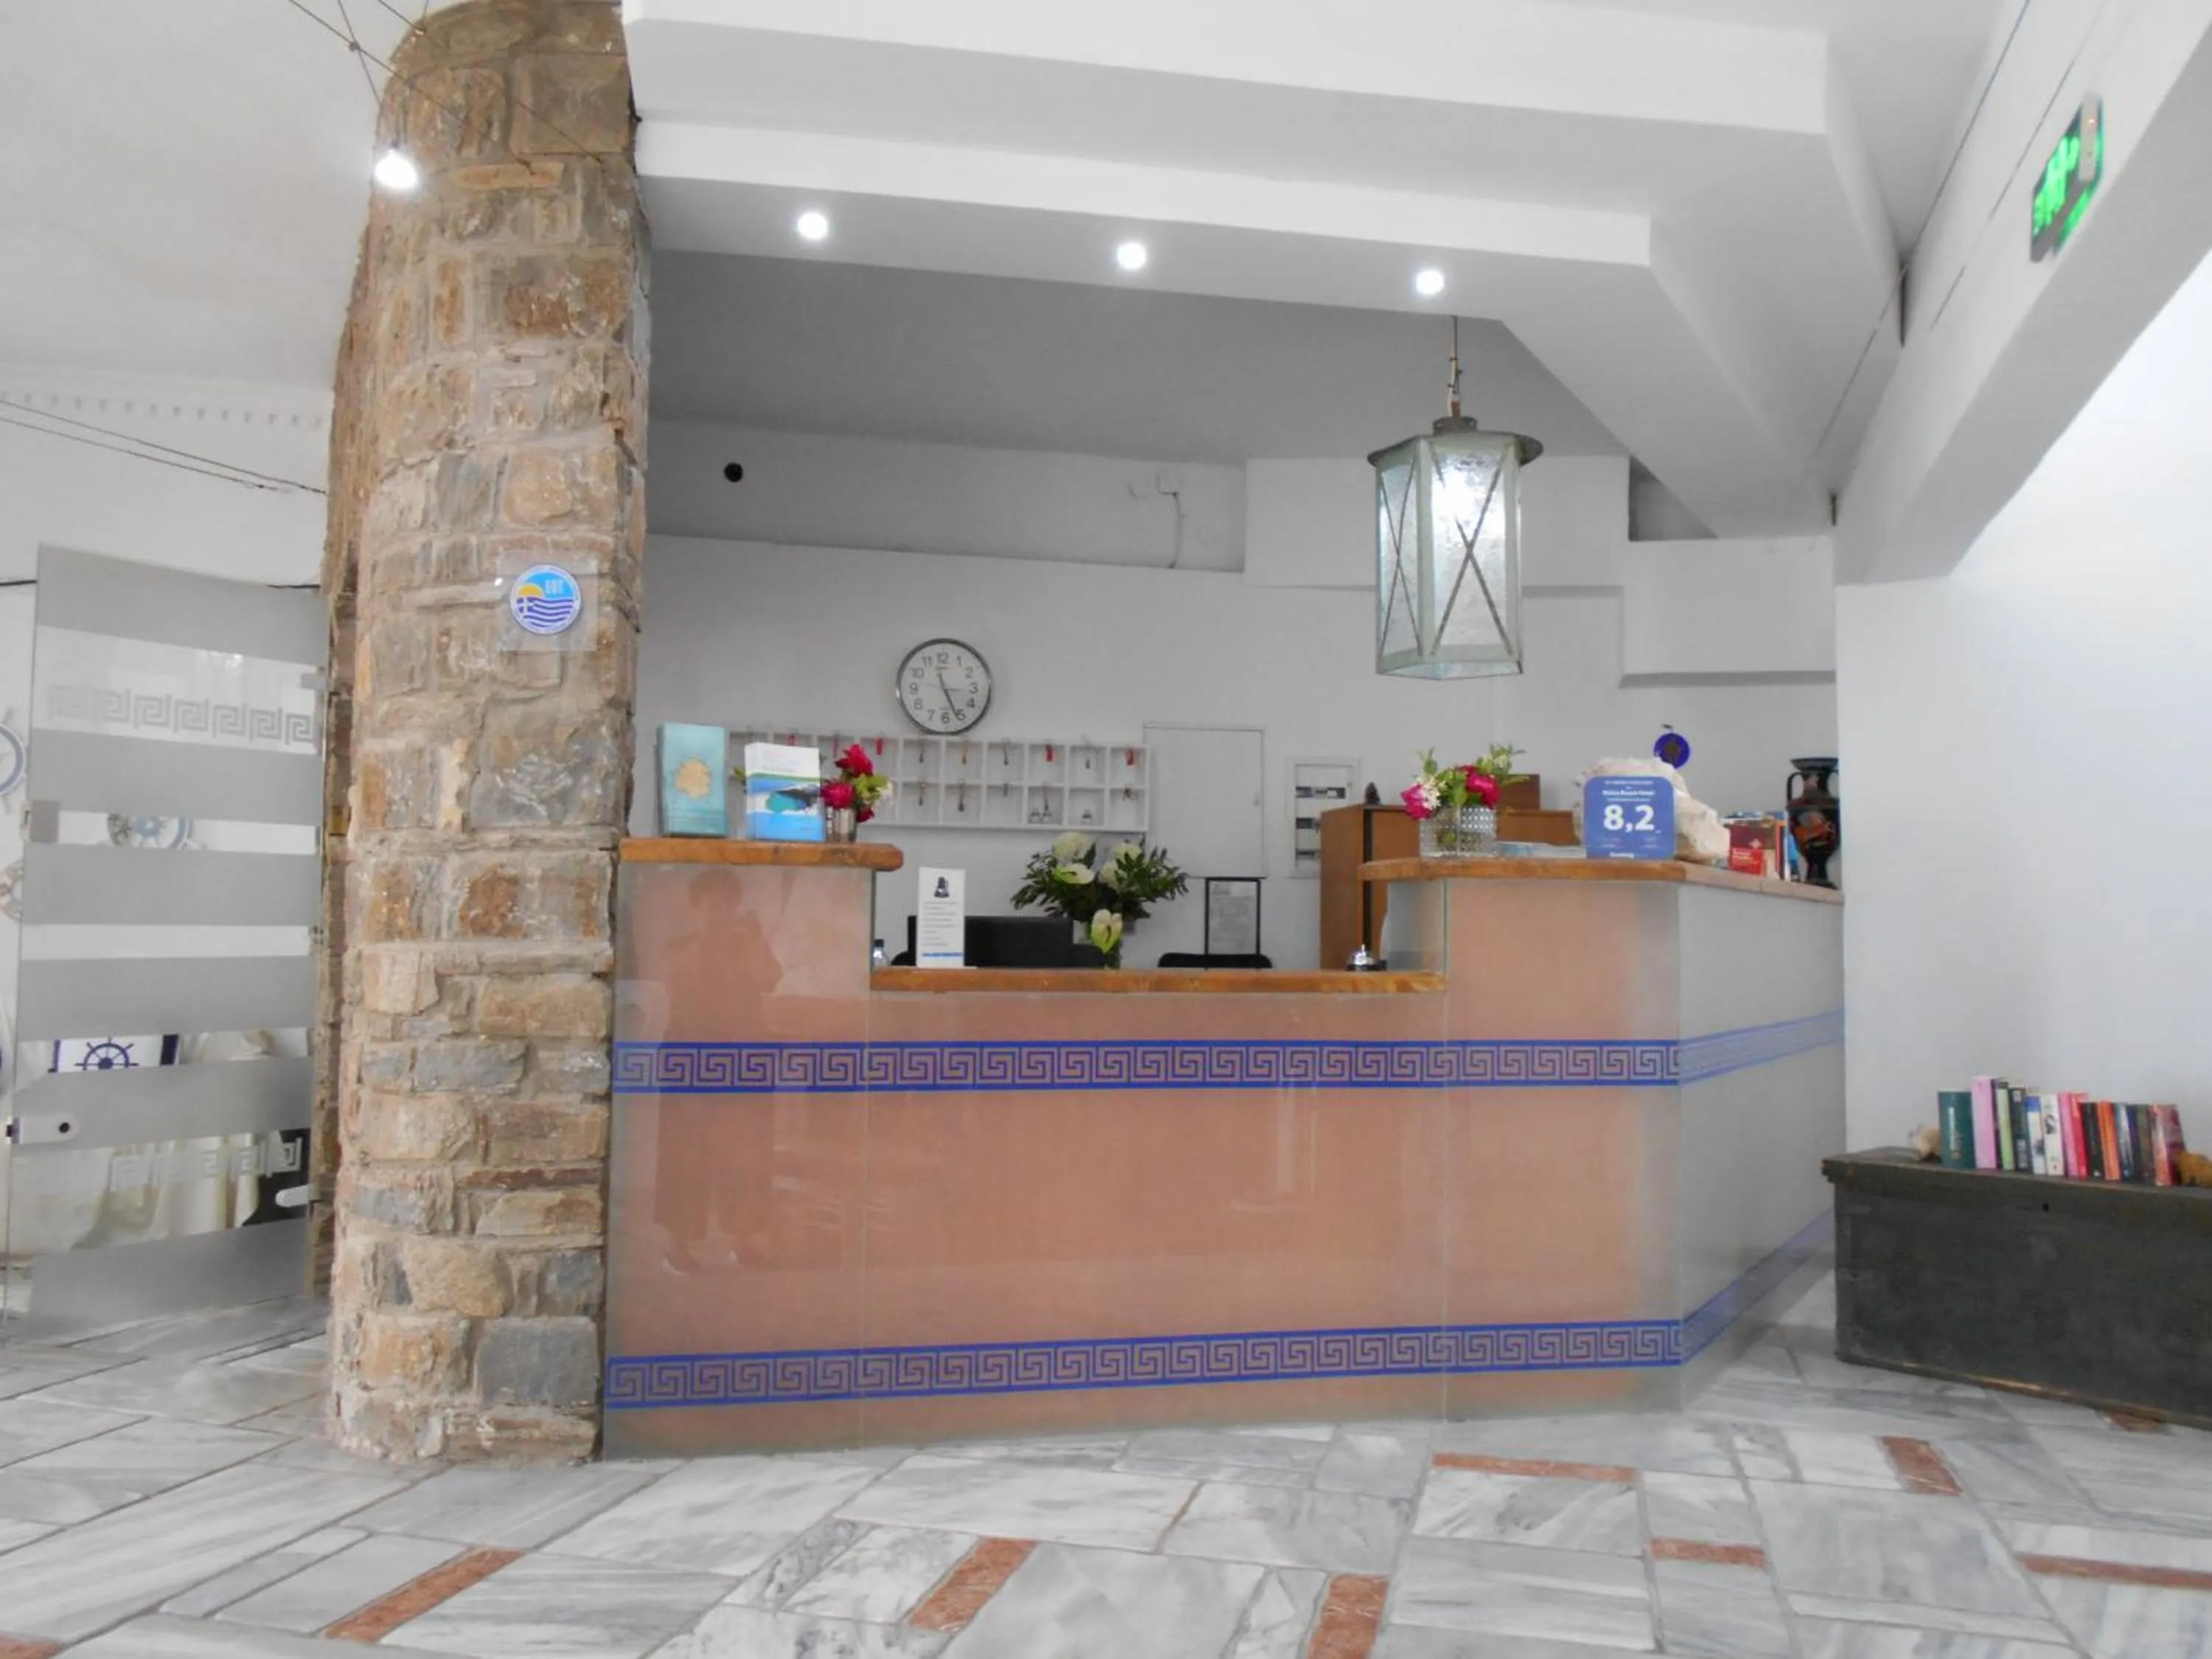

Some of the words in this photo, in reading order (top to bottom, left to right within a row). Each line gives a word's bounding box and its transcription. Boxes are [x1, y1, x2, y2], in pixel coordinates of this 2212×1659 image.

[922, 656, 931, 667] 11
[936, 653, 949, 664] 12
[957, 655, 962, 667] 1
[912, 667, 925, 679] 10
[965, 667, 973, 678] 2
[909, 682, 918, 694] 9
[969, 682, 978, 693] 3
[967, 698, 975, 709] 4
[927, 709, 936, 720] 7
[941, 712, 950, 724] 6
[1604, 804, 1655, 832] 8,2
